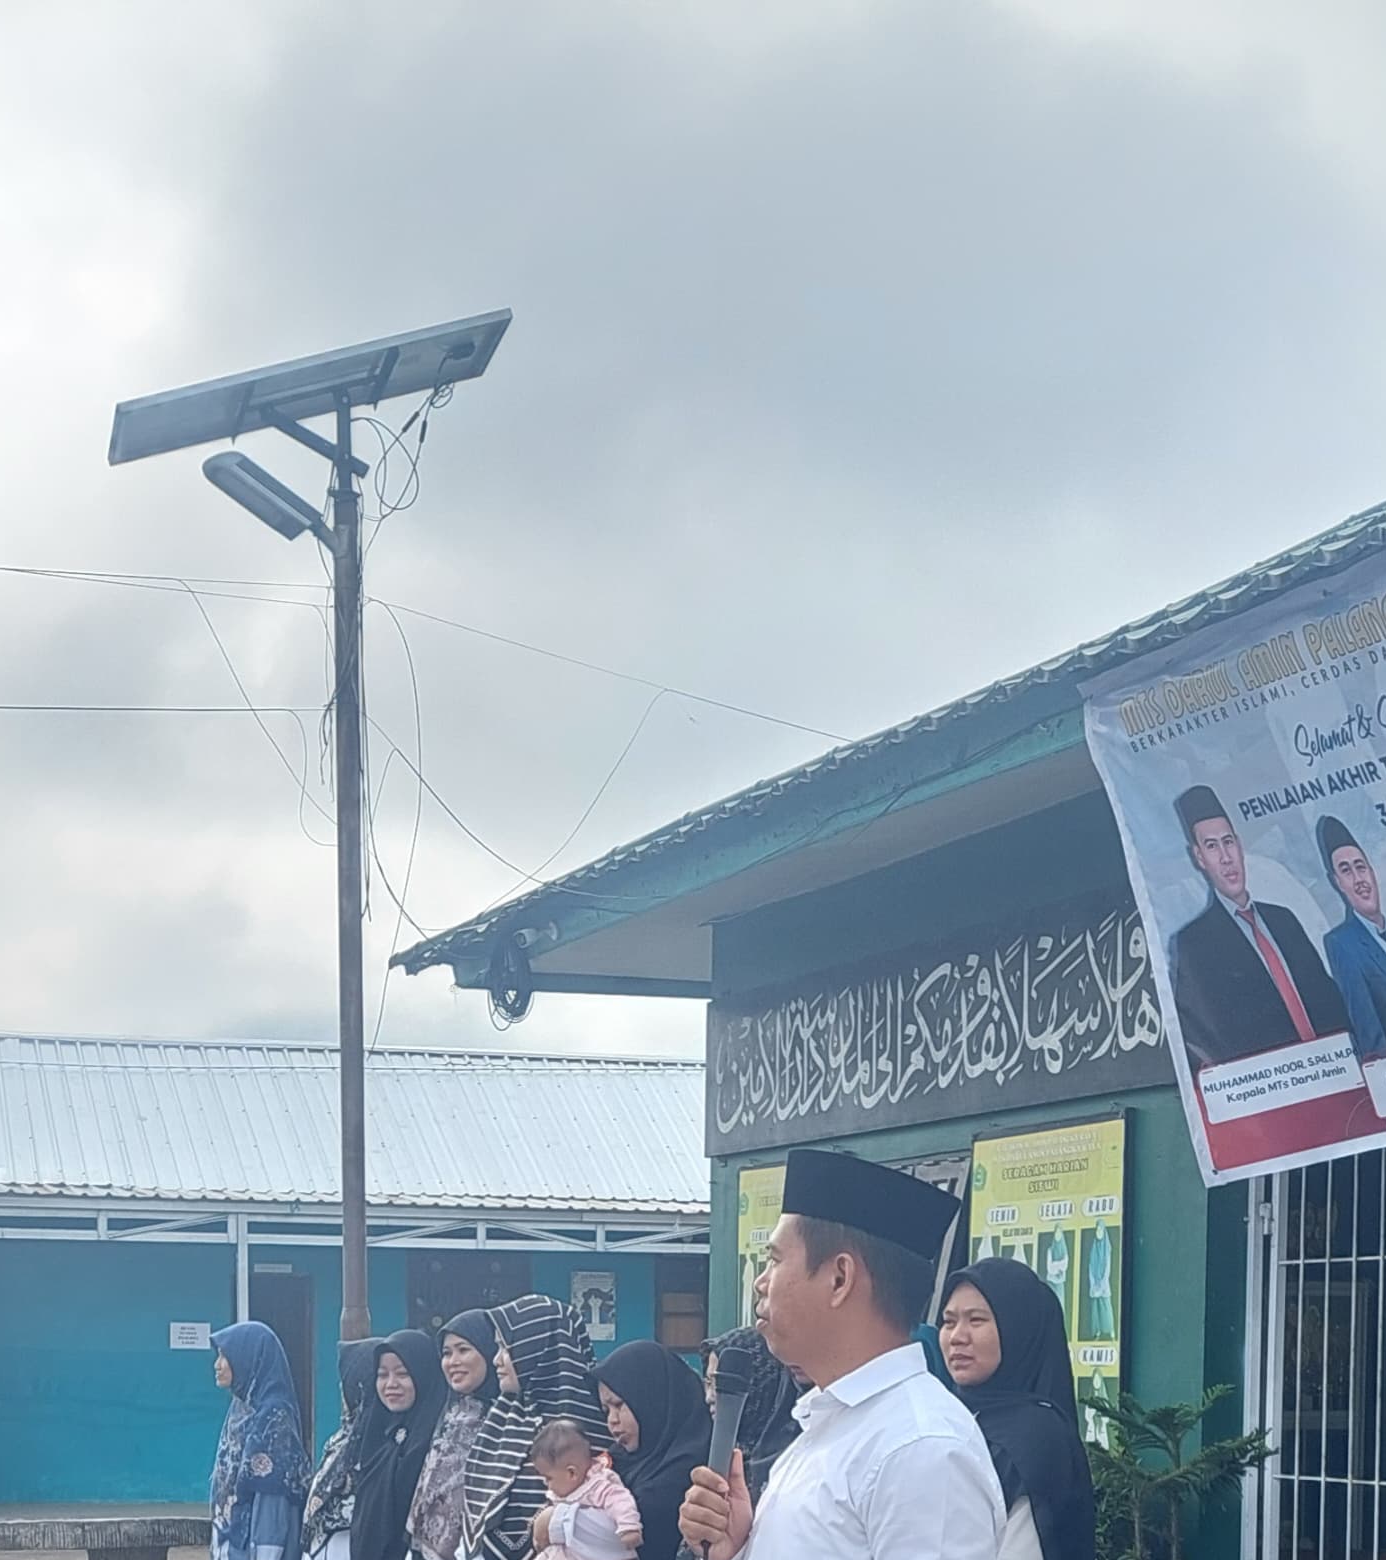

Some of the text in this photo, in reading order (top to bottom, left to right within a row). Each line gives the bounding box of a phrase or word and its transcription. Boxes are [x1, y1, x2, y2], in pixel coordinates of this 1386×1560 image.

[1163, 658, 1240, 719] DARUL
[1237, 630, 1305, 692] AMIN
[1130, 706, 1230, 753] BERKARAKTER
[1234, 683, 1296, 715] ISLAMI,
[1301, 656, 1361, 689] CERDAS
[1294, 714, 1356, 767] Selamat
[1355, 703, 1376, 740] &
[1237, 777, 1326, 821] PENILAIAN
[1327, 760, 1382, 795] AKHIR
[1203, 1068, 1273, 1095] MUHAMMAD
[1226, 1065, 1347, 1104] Kepala MTs Darul Amin
[1048, 1157, 1089, 1175] HARIAN
[989, 1198, 1116, 1223] SENIN SELASA RABU
[1081, 1349, 1115, 1362] KAMIS
